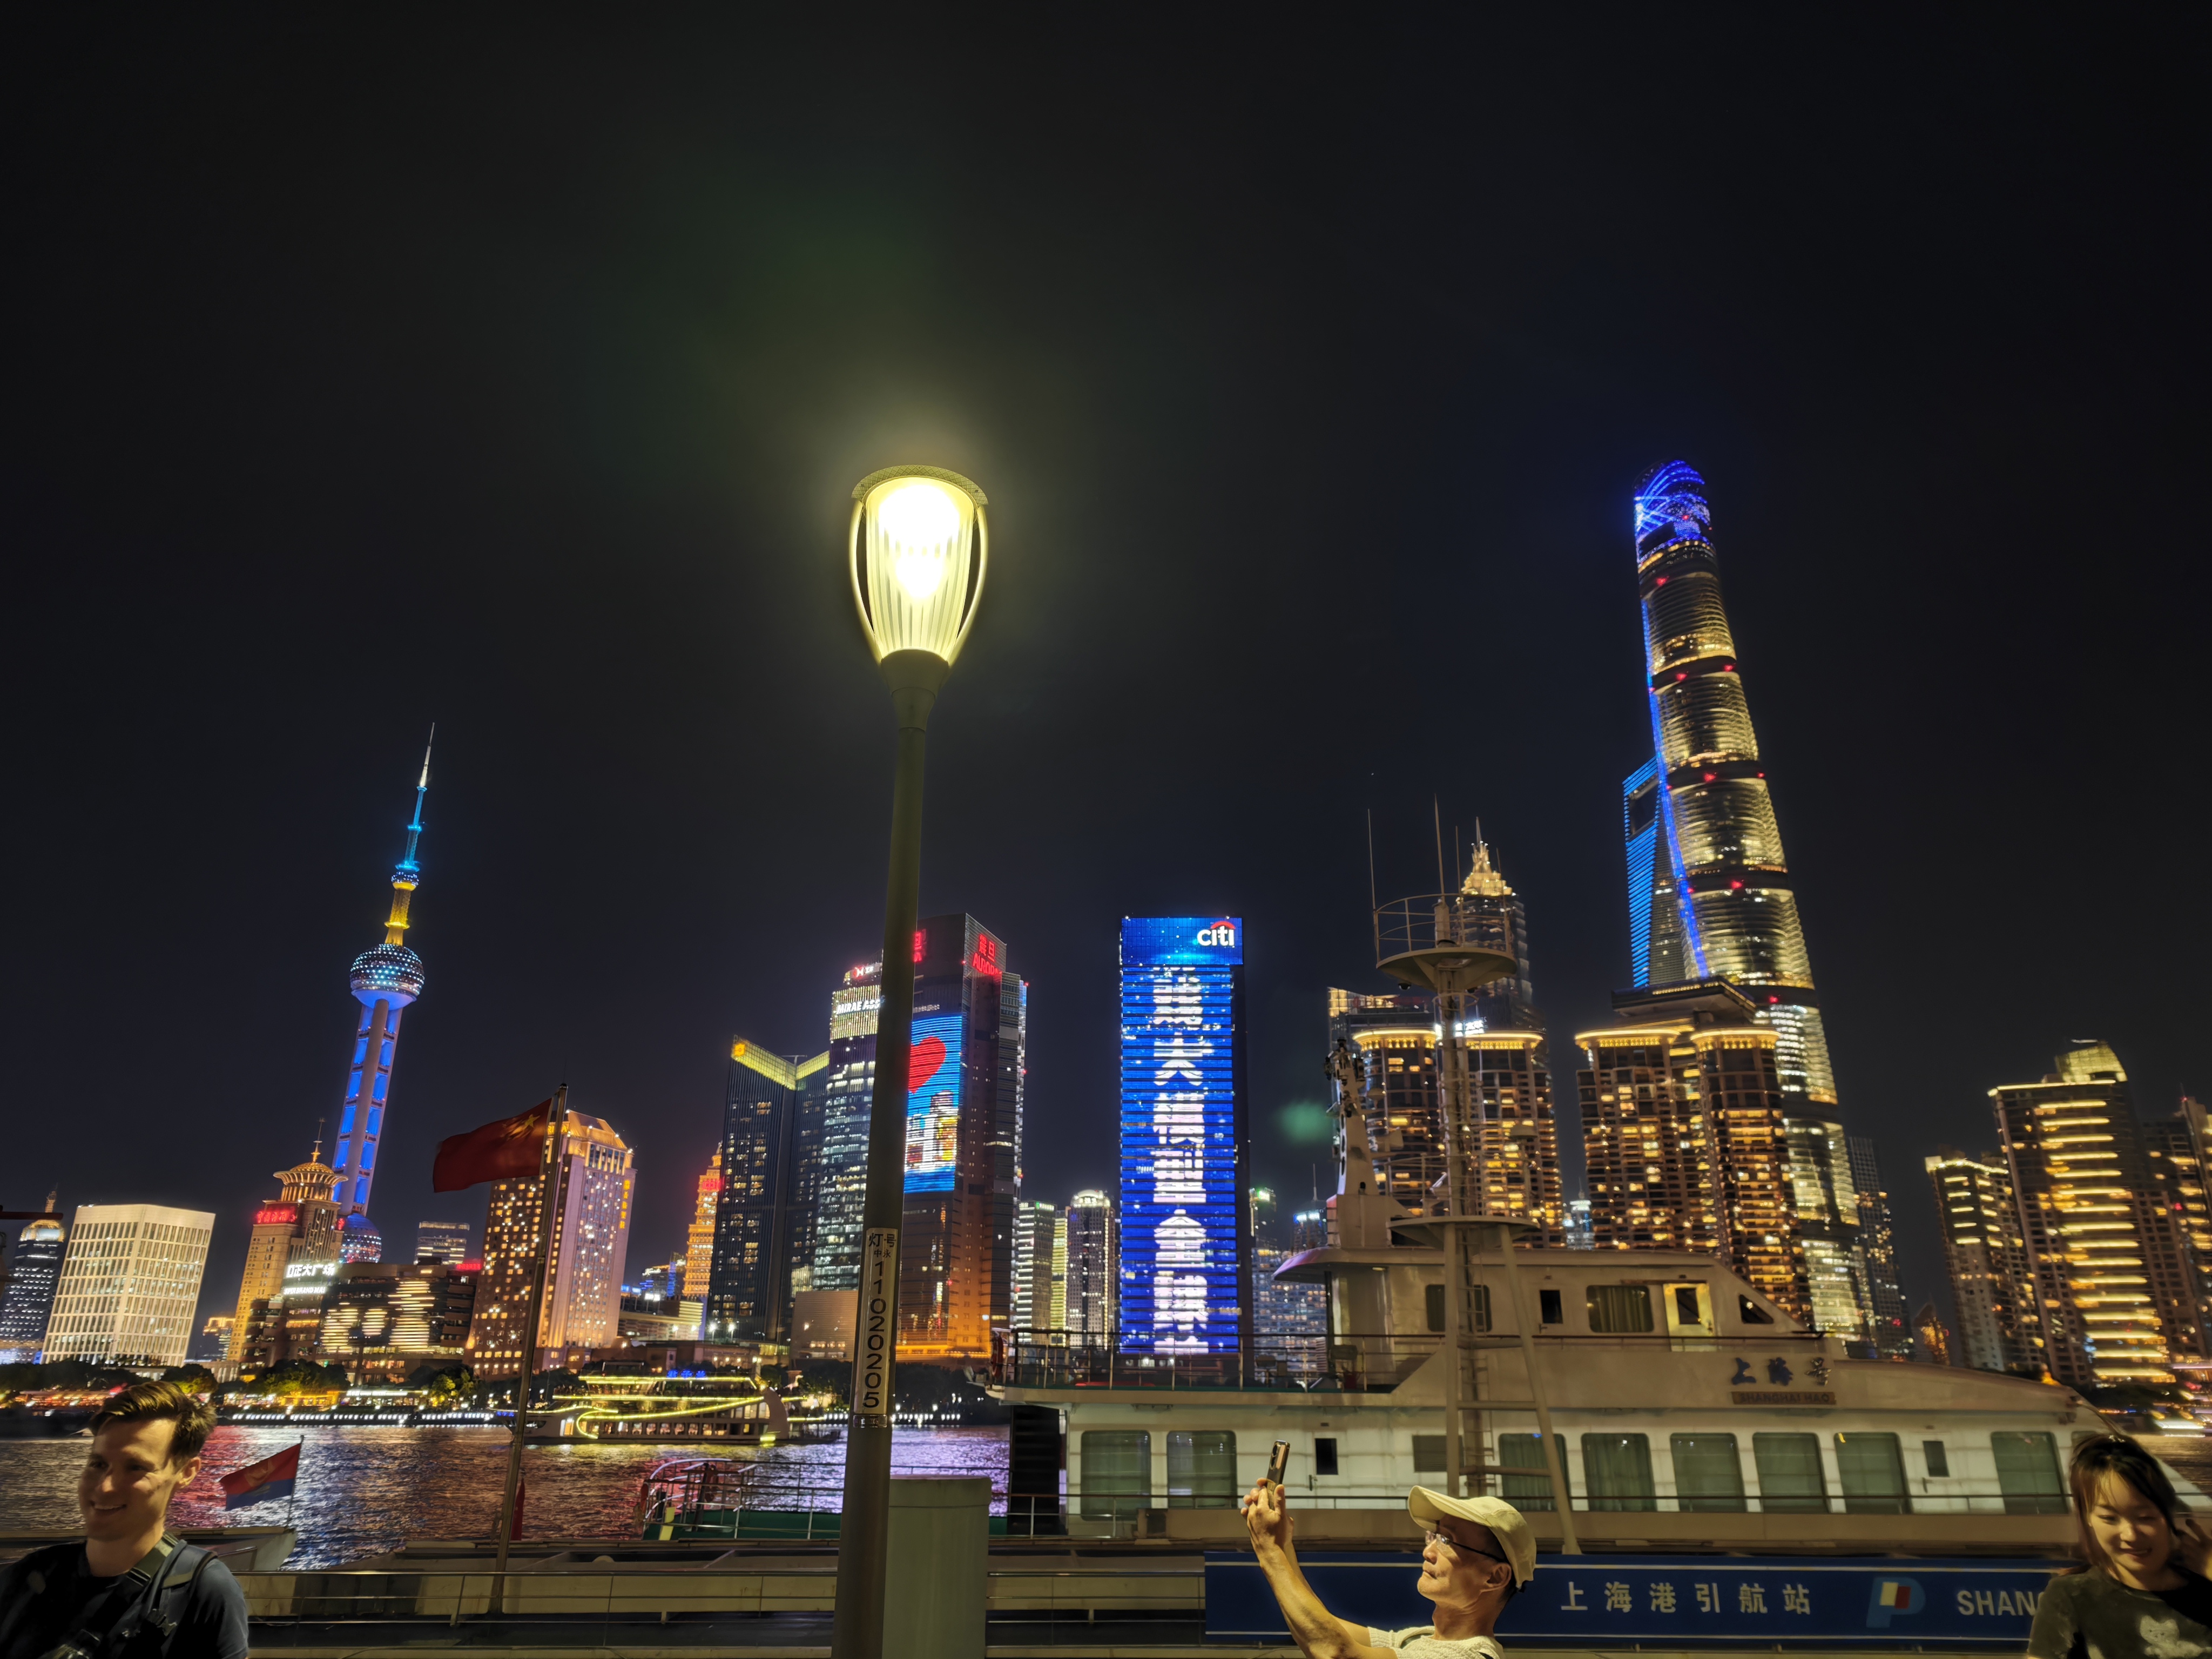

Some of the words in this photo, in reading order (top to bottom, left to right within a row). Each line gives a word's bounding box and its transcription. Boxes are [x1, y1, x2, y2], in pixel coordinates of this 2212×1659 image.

[1197, 925, 1235, 946] citi
[837, 1001, 862, 1015] MIRAE
[862, 998, 885, 1010] ASS
[868, 1232, 896, 1247] 灯号
[293, 1263, 336, 1277] 正大广场
[862, 1260, 887, 1408] 11020205
[1560, 1581, 1811, 1615] 上海港引航站
[1957, 1590, 2039, 1616] SHAN
